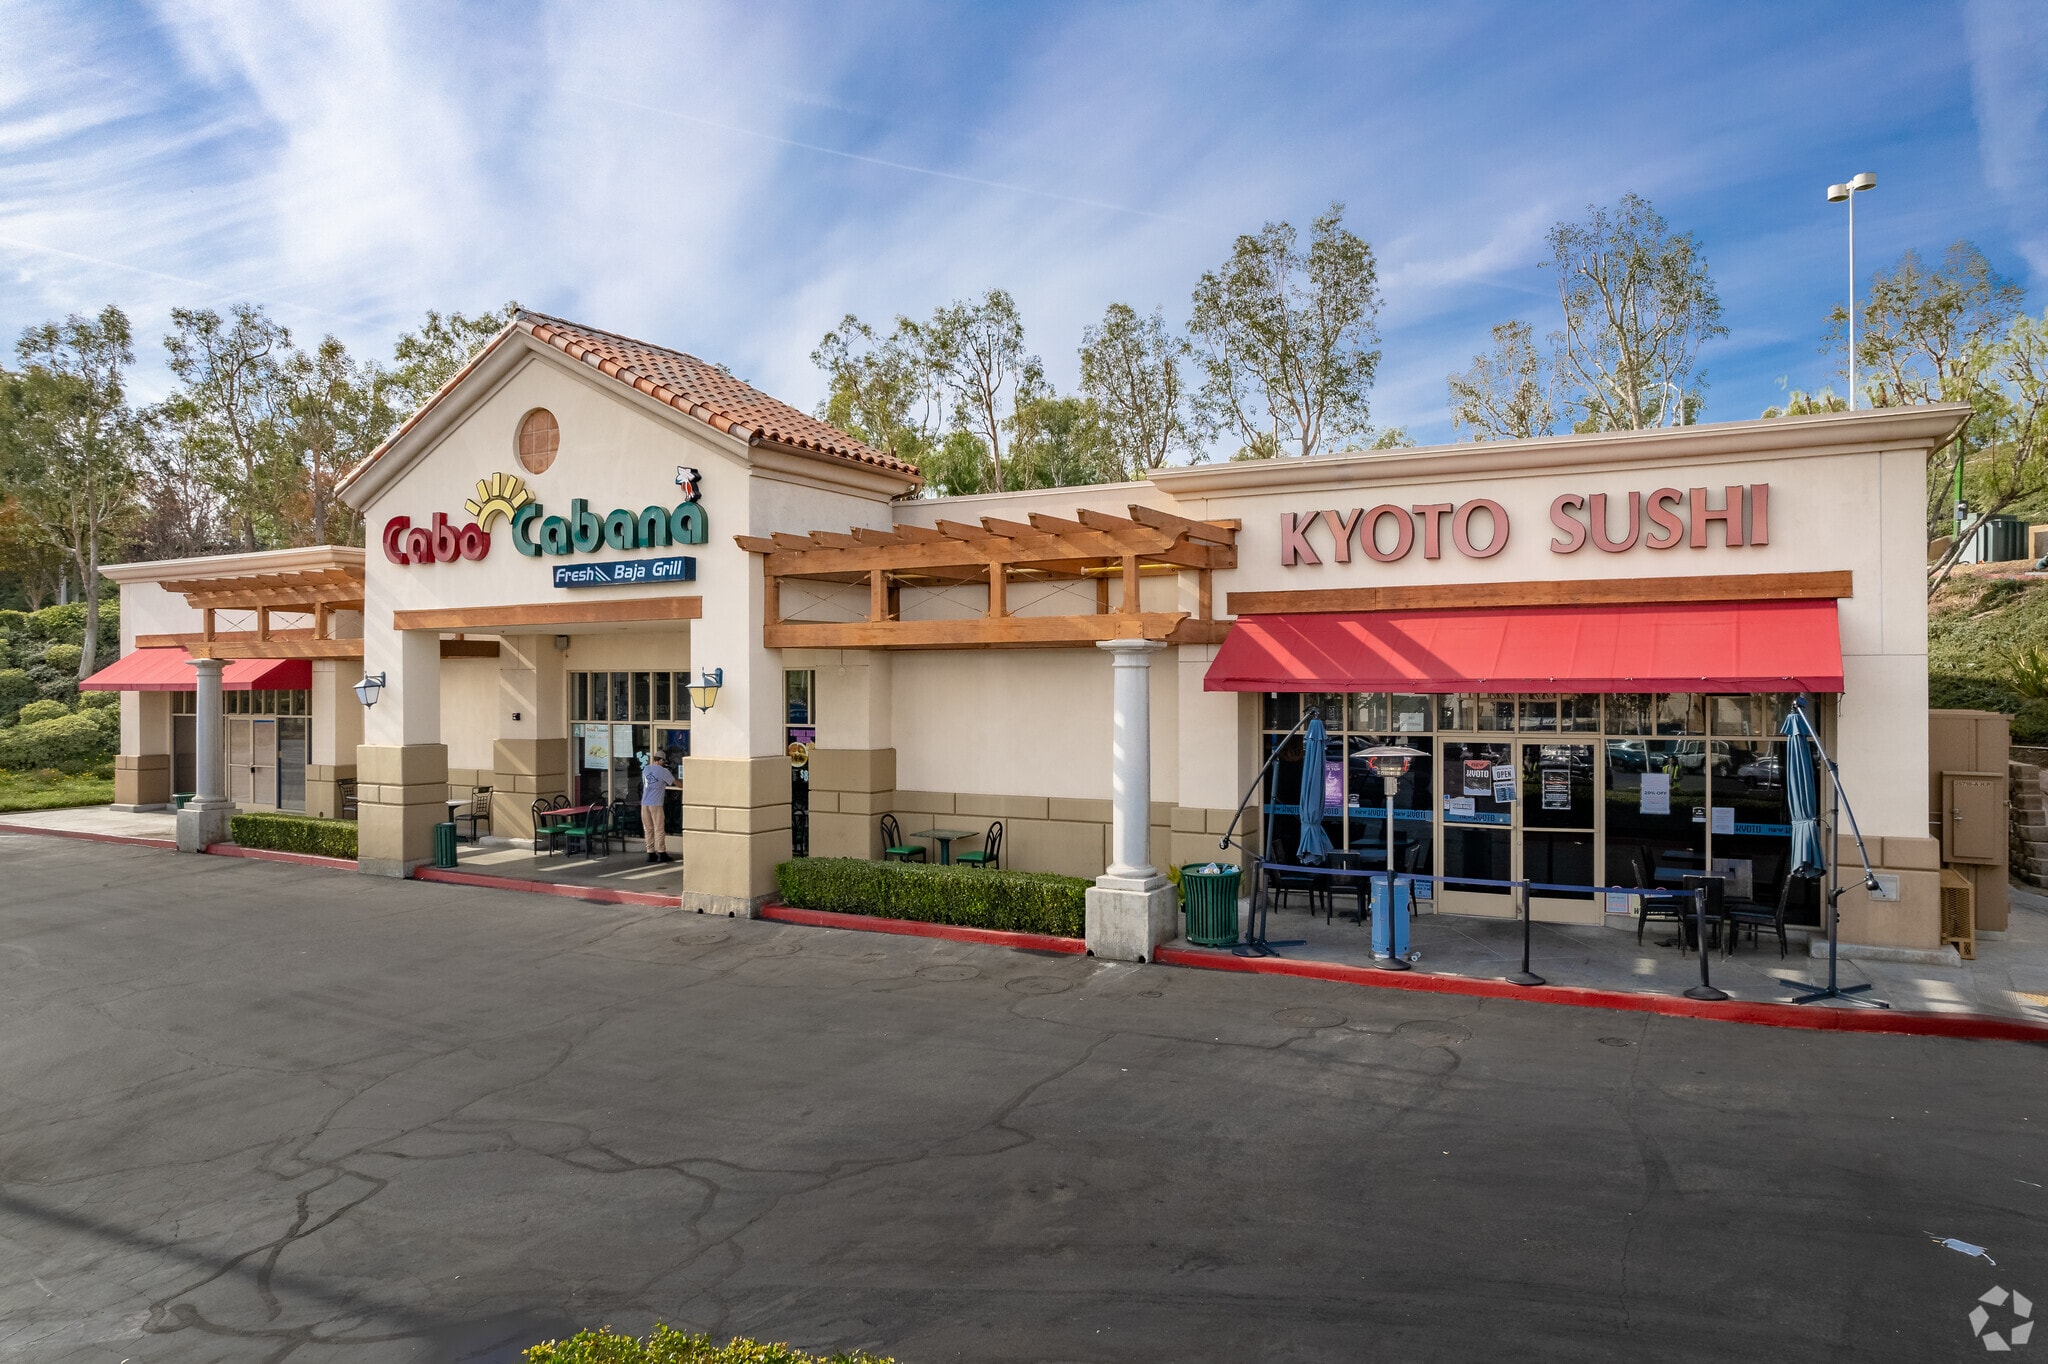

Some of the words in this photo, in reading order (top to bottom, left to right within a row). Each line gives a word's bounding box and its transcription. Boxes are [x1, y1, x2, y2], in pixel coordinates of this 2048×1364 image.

[1281, 498, 1510, 566] KYOTO
[1549, 483, 1769, 554] SUSHI
[383, 512, 490, 565] Cabo
[512, 498, 708, 557] Cabana
[555, 566, 594, 583] Fresh
[614, 563, 646, 581] Baja
[652, 559, 682, 576] Grill
[656, 703, 691, 714] BEVRAG
[1466, 769, 1489, 778] KYOTO
[1496, 770, 1512, 778] OPEN
[1282, 806, 1300, 814] KYOT
[1736, 825, 1761, 833] KYOTO
